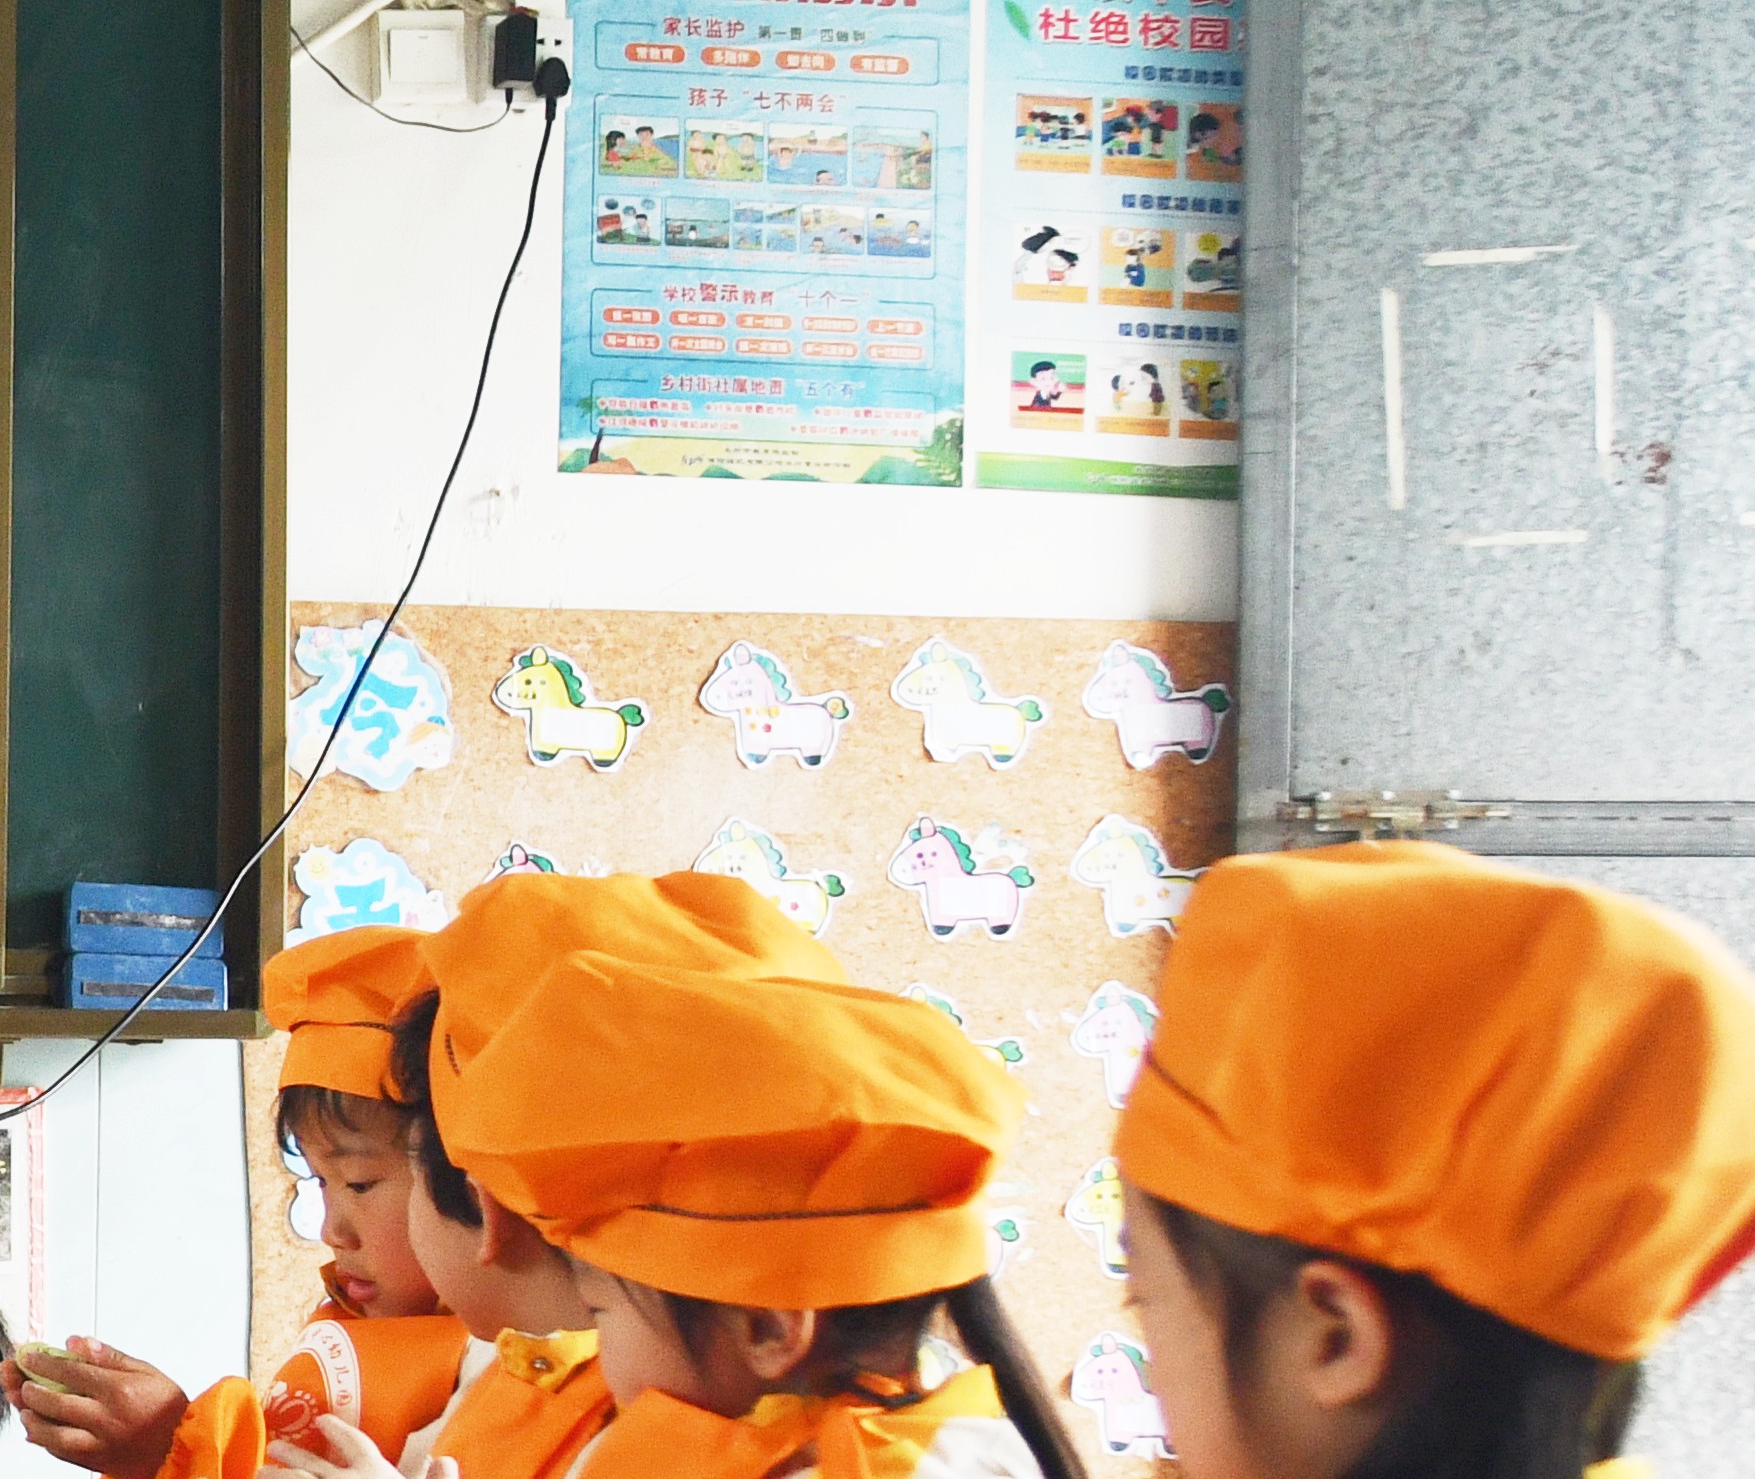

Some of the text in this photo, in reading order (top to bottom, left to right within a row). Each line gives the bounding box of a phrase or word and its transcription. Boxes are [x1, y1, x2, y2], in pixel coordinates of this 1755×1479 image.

[662, 16, 746, 40] 家长监护
[1039, 7, 1243, 51] 杜绝校园
[688, 87, 729, 108] 孩子
[662, 281, 775, 306] 学校警示教育
[660, 375, 785, 397] 乡村街社属地责
